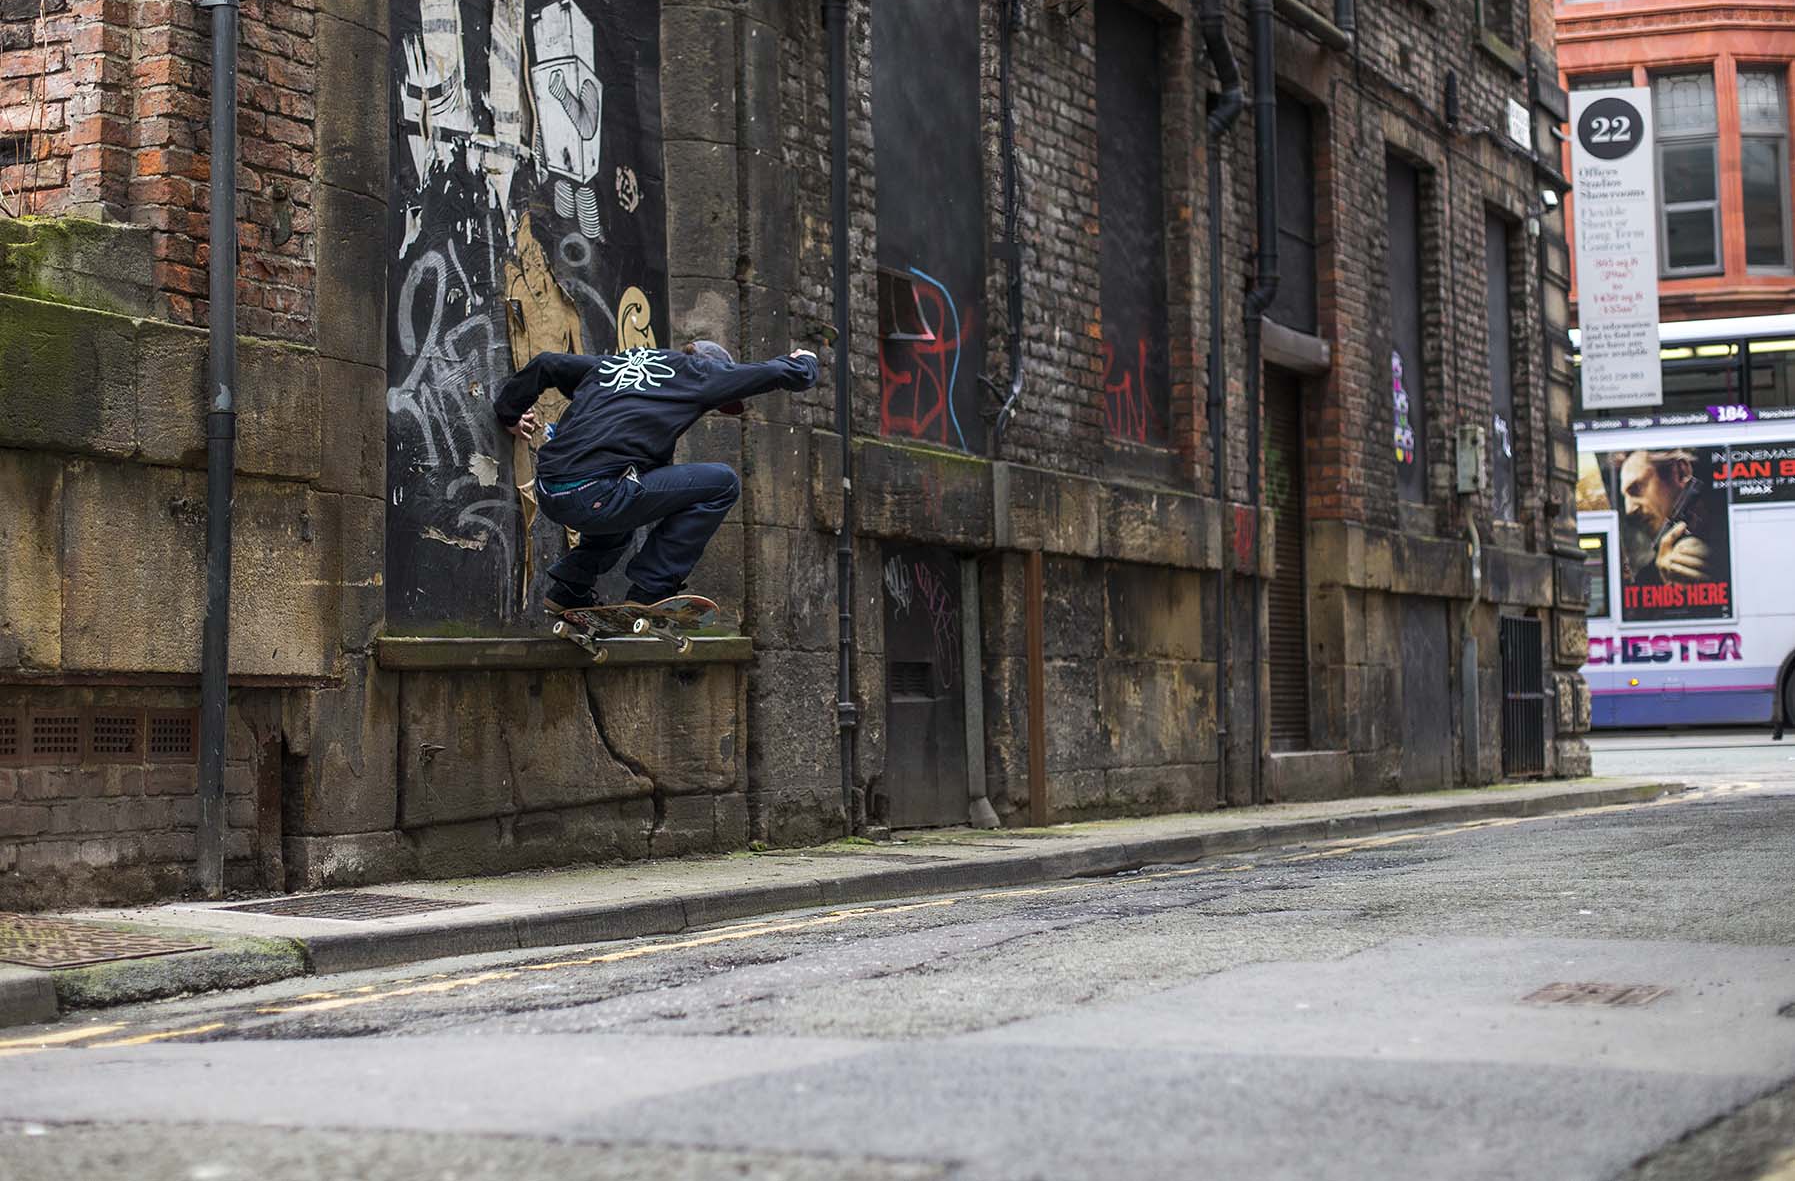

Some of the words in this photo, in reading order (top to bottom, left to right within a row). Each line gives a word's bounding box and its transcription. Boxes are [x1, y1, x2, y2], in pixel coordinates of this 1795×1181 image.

[1591, 115, 1631, 143] 22
[1580, 190, 1645, 200] Showrooms
[1717, 404, 1749, 422] 184
[1712, 451, 1728, 463] IN
[1713, 461, 1771, 480] JAN
[1779, 459, 1795, 476] 8
[1713, 477, 1774, 489] EXERIENCE
[1740, 484, 1773, 495] IMAX
[1624, 586, 1639, 608] IT
[1642, 583, 1684, 607] ENDS
[1686, 582, 1729, 606] HERE
